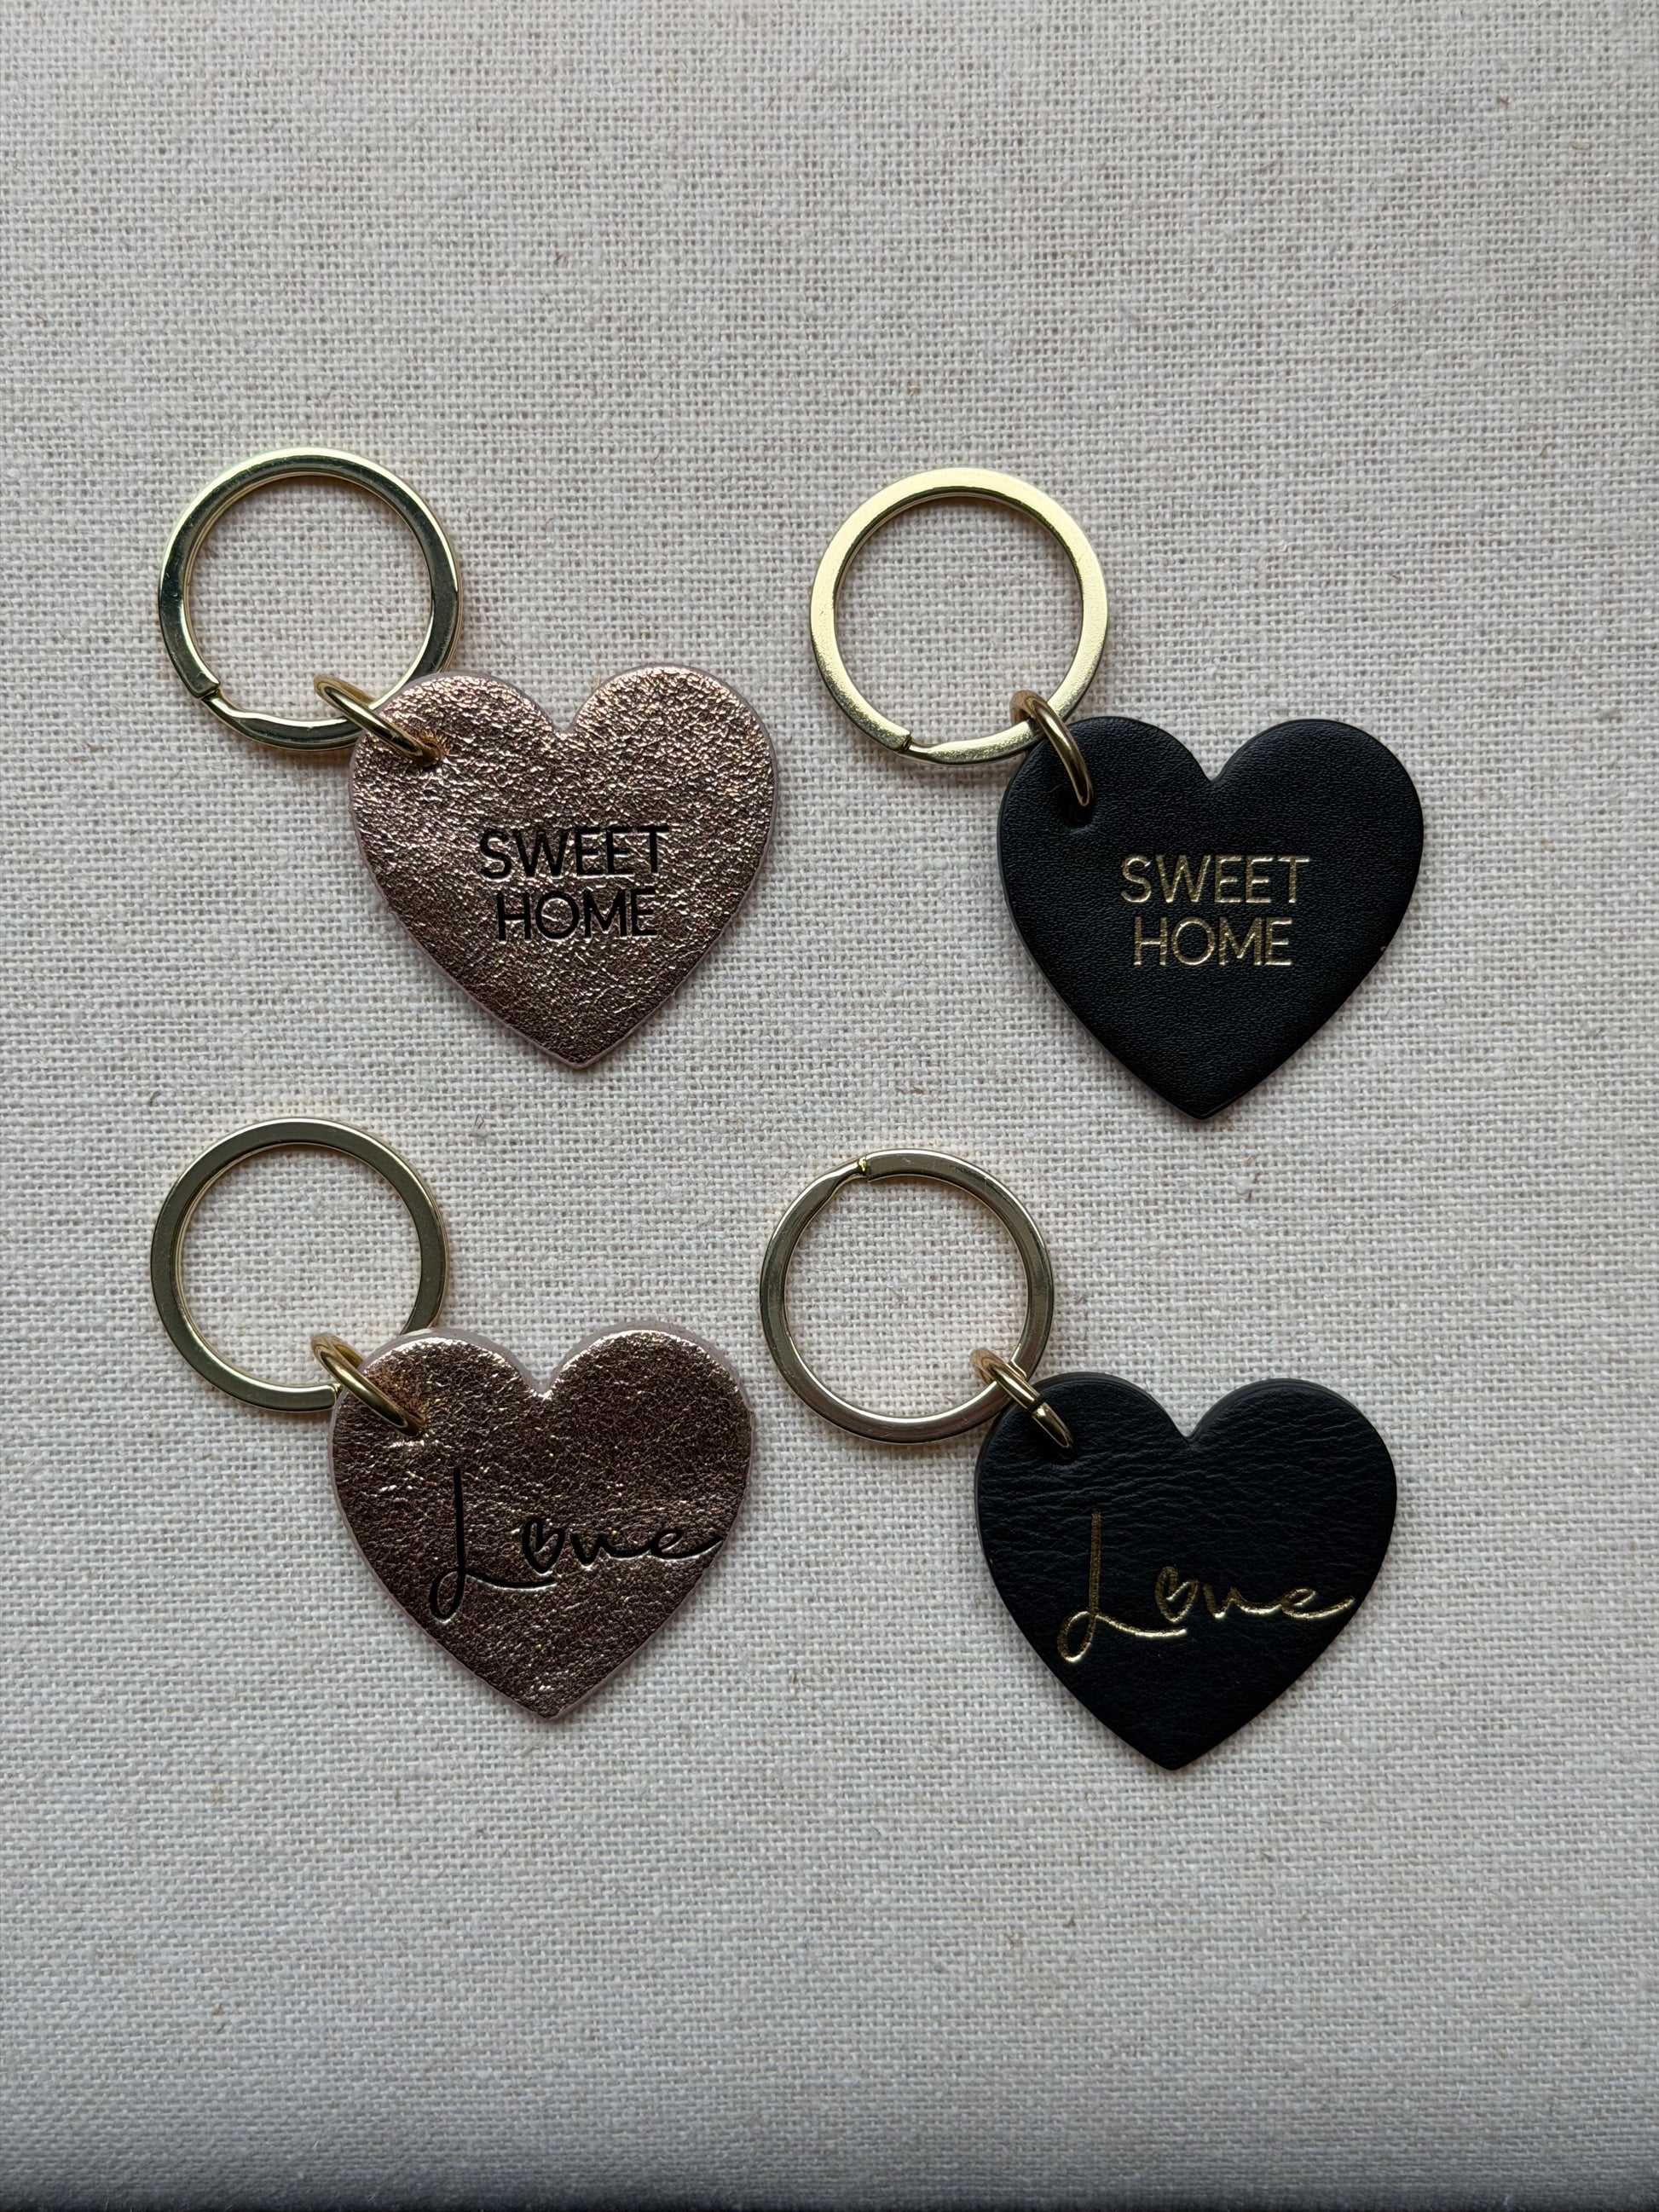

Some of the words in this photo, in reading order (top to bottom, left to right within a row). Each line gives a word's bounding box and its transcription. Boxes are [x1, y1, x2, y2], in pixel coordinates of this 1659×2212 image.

[479, 824, 669, 878] SWEET
[1120, 854, 1310, 904] SWEET
[497, 886, 658, 942] HOME
[1133, 915, 1292, 966] HOME
[428, 1466, 723, 1620] Love
[1056, 1509, 1356, 1662] Love
